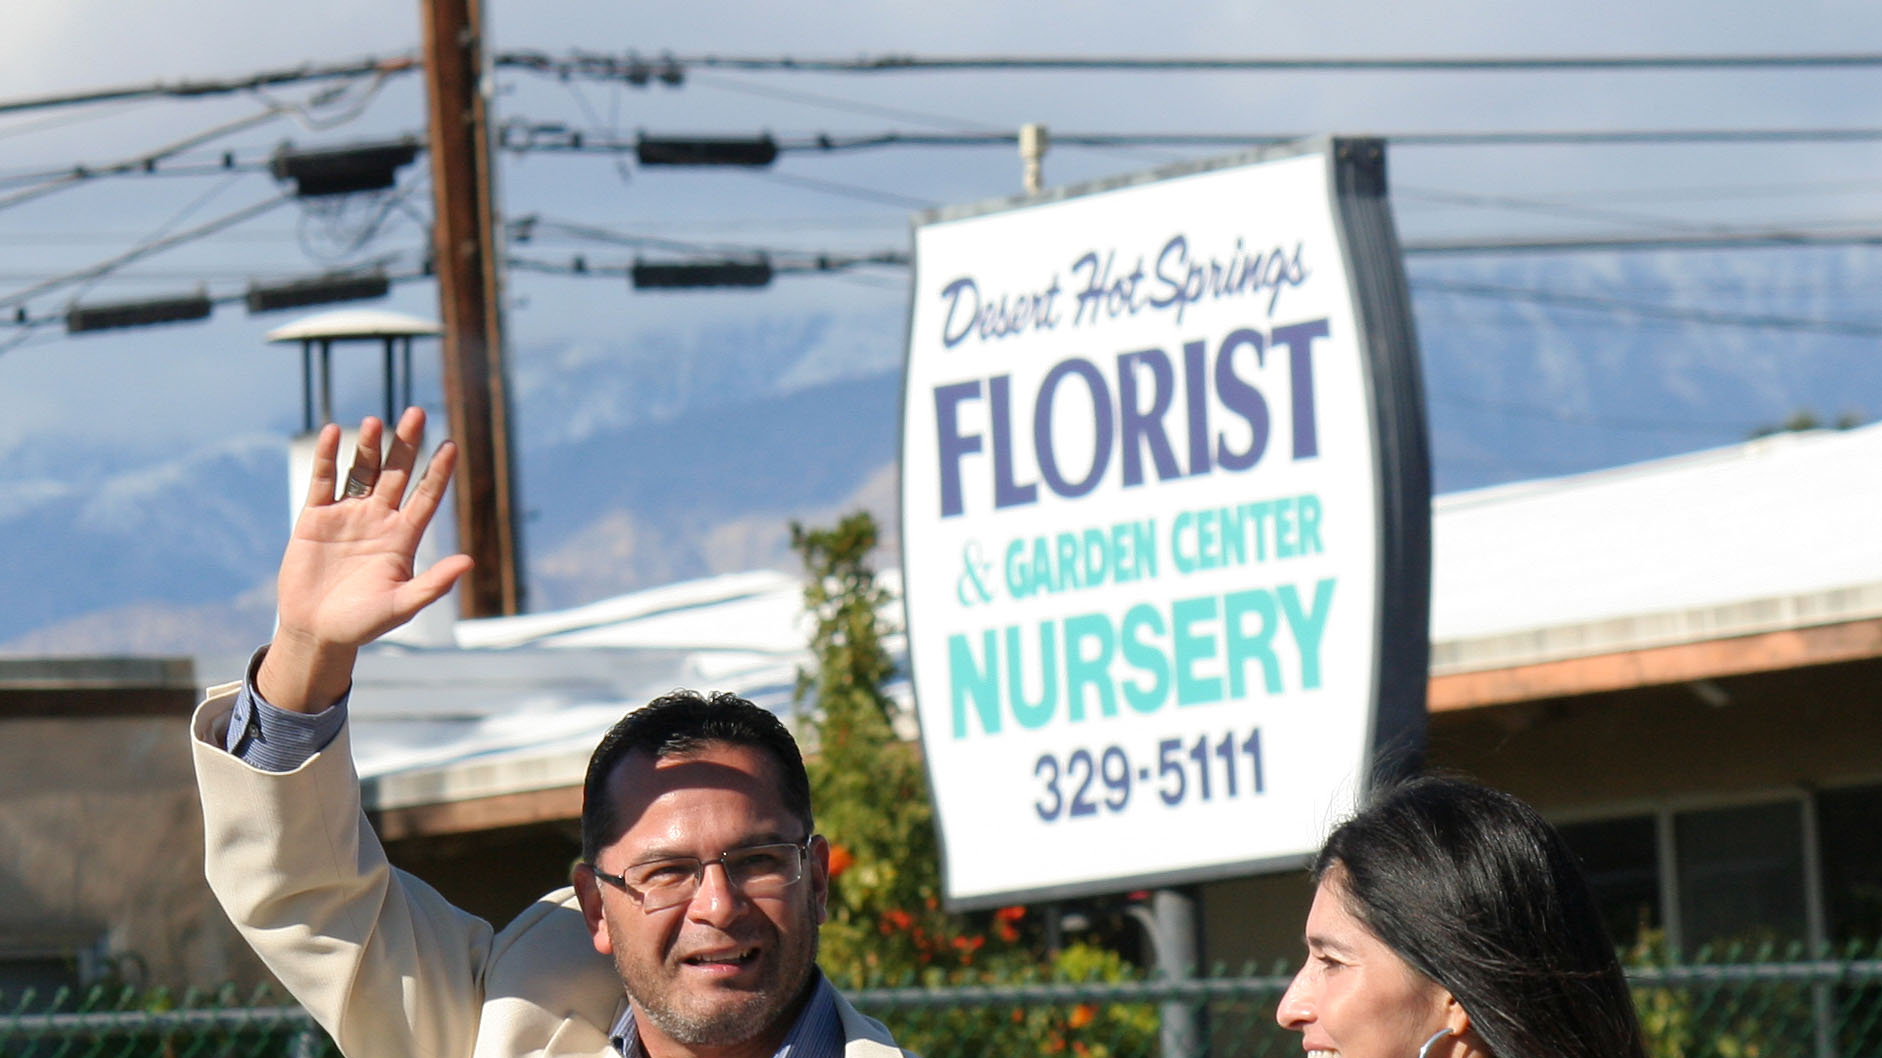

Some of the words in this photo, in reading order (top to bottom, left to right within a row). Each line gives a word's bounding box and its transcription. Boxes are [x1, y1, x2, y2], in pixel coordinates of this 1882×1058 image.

[941, 276, 1062, 348] Desert
[1072, 248, 1147, 327] Hot
[1148, 234, 1311, 325] Springs
[934, 317, 1331, 519] FLORIST
[956, 539, 994, 607] &
[1005, 519, 1159, 601] GARDEN
[1171, 493, 1324, 575] CENTER
[948, 577, 1338, 740] NURSERY
[1033, 727, 1266, 824] 329-5111
